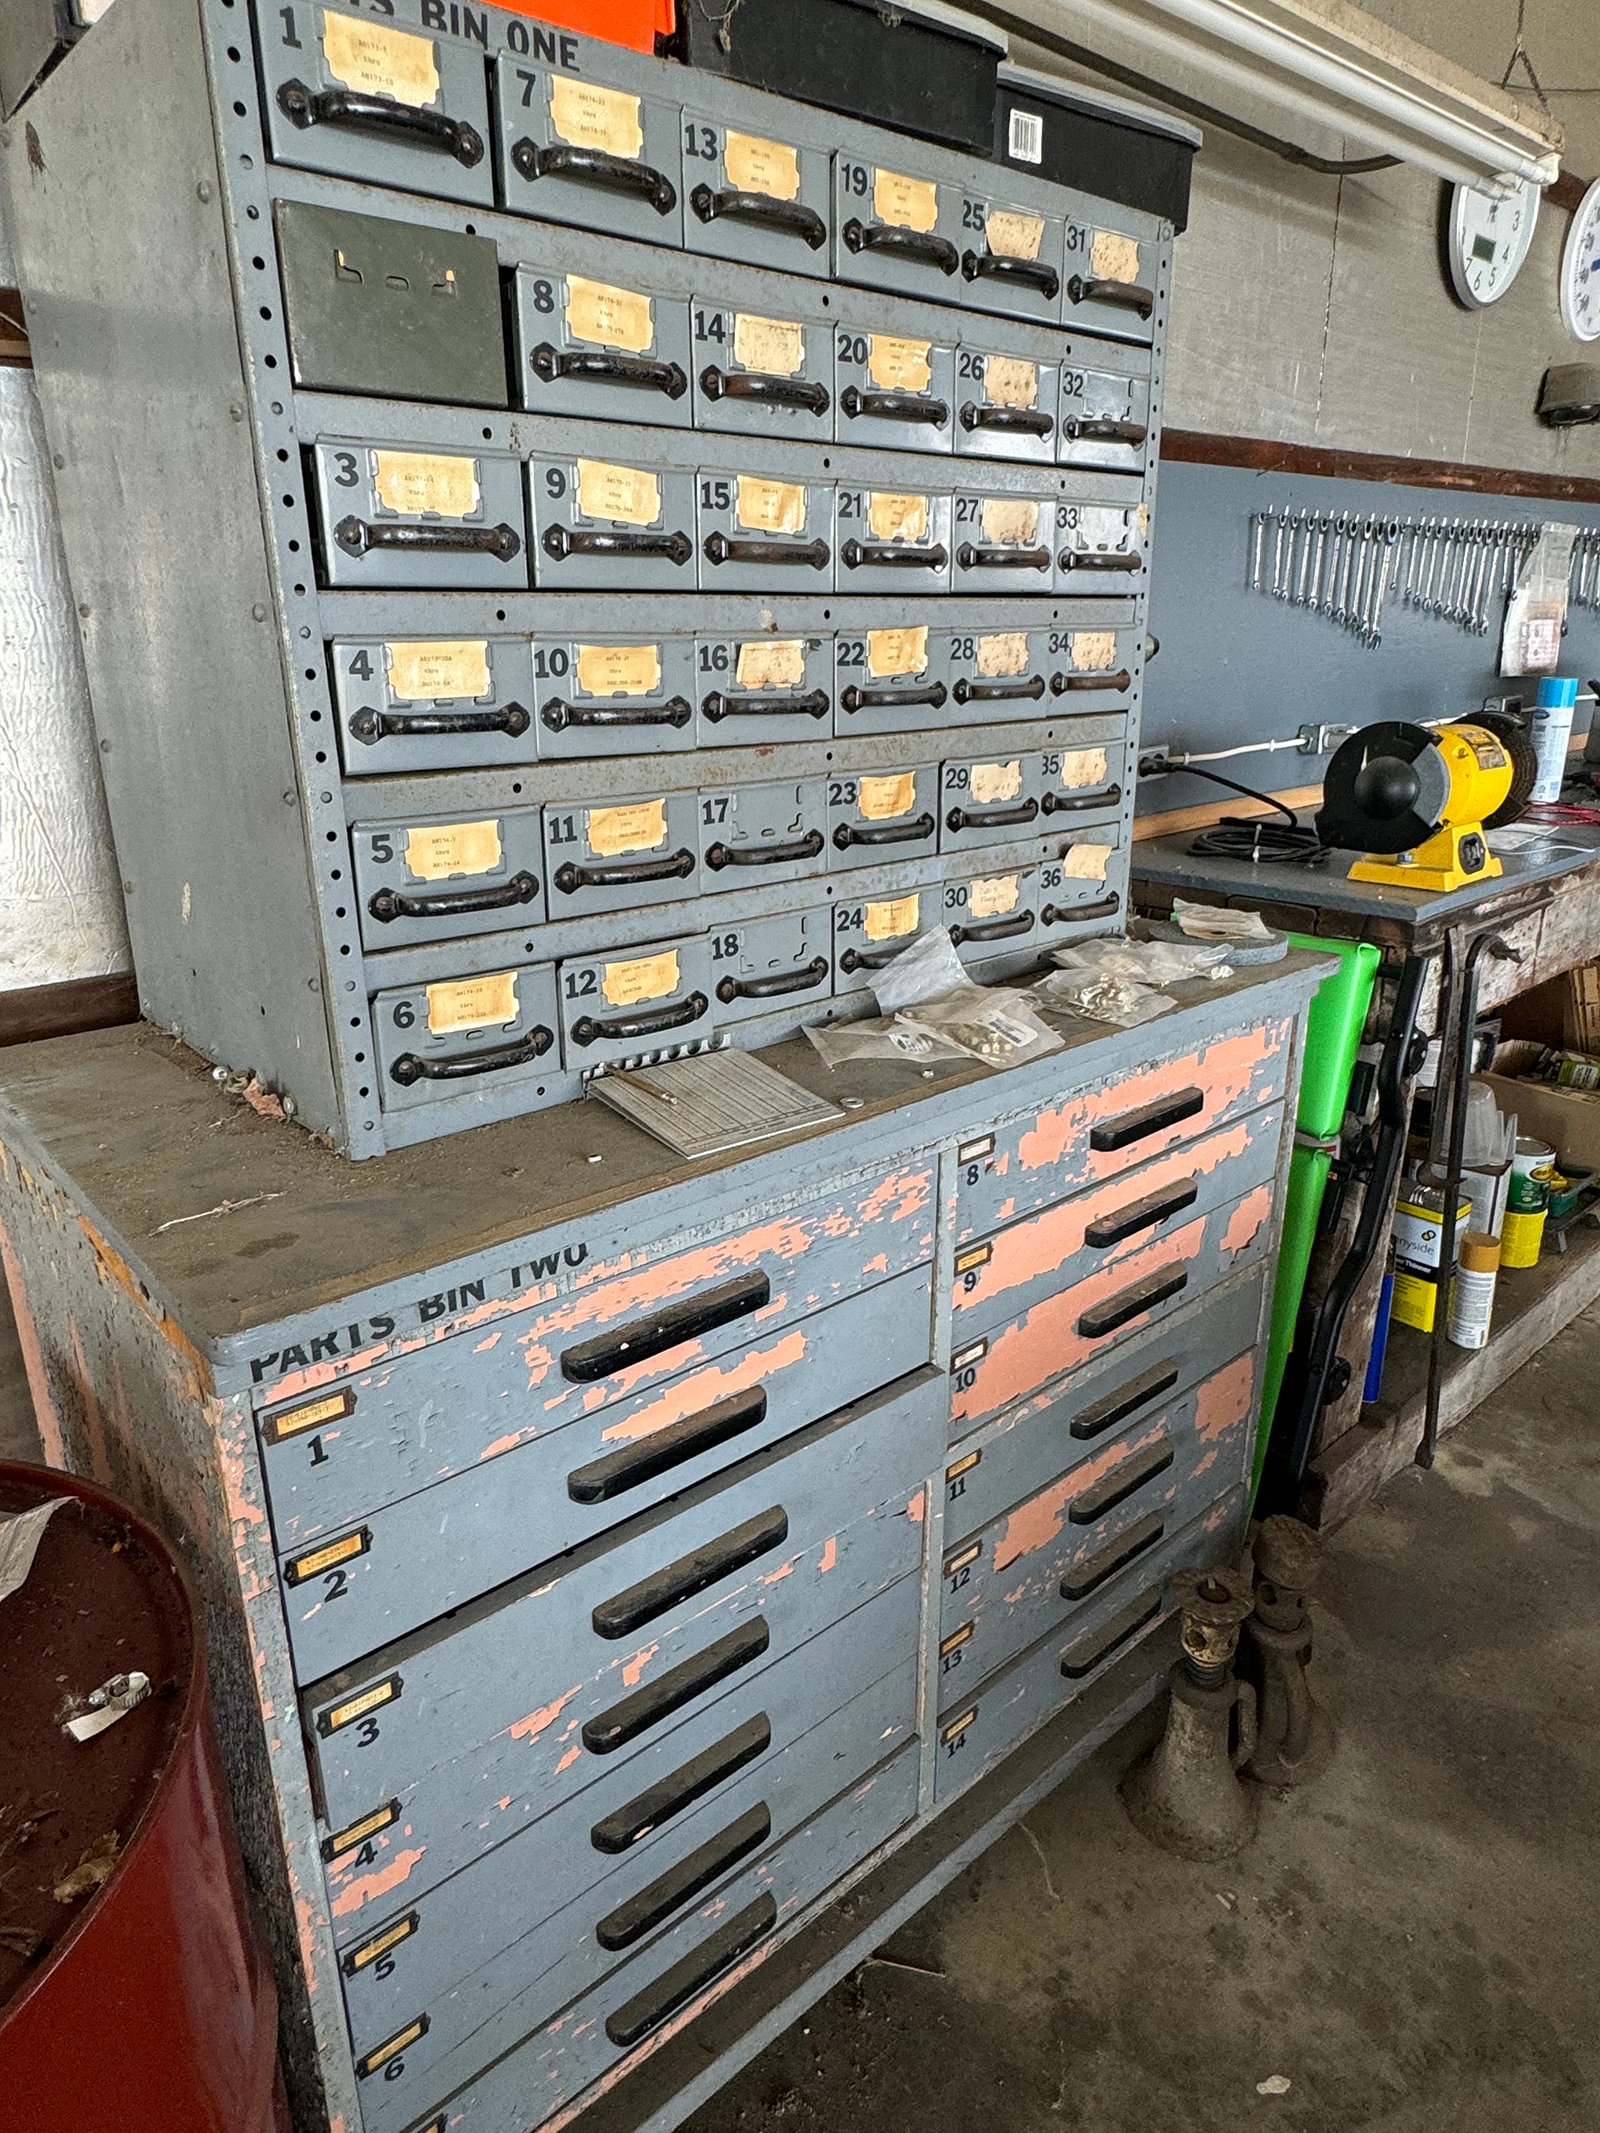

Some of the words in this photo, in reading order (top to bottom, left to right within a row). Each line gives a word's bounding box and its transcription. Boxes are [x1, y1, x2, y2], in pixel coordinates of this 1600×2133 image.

[280, 6, 302, 49] 1
[421, 0, 488, 51] BIN
[507, 20, 580, 72] ONE
[517, 69, 535, 107] 7
[685, 124, 717, 161] 13
[842, 164, 867, 196] 19
[963, 200, 986, 233] 25
[1512, 210, 1520, 231] 3
[1067, 226, 1085, 252] 31
[1466, 257, 1473, 272] 7
[1502, 244, 1510, 263] 4
[1474, 271, 1482, 291] 6
[1489, 266, 1497, 287] 5
[534, 280, 554, 313] 8
[695, 311, 725, 343] 14
[838, 335, 868, 364] 20
[960, 353, 984, 380] 26
[1063, 372, 1083, 397] 32
[335, 453, 359, 487] 3
[546, 468, 565, 498] 9
[702, 482, 730, 510] 15
[839, 492, 860, 518] 21
[956, 498, 978, 522] 27
[1057, 507, 1077, 529] 33
[837, 642, 864, 666] 22
[951, 638, 973, 660] 28
[1049, 633, 1069, 654] 34
[349, 650, 374, 681] 4
[535, 649, 568, 678] 10
[700, 645, 728, 671] 16
[1042, 755, 1058, 775] 35
[946, 768, 968, 789] 29
[829, 782, 856, 806] 23
[703, 798, 728, 825] 17
[549, 816, 577, 844] 11
[372, 834, 393, 863] 5
[1041, 868, 1061, 889] 36
[945, 887, 967, 908] 30
[837, 908, 864, 931] 24
[712, 934, 738, 960] 18
[566, 970, 597, 999] 12
[393, 1002, 414, 1028] 6
[967, 1165, 978, 1186] 8
[964, 1271, 976, 1292] 9
[419, 1279, 486, 1323] BIN
[956, 1368, 975, 1393] 10
[307, 1435, 329, 1466] 1
[949, 1478, 966, 1500] 11
[322, 1570, 348, 1603] 2
[950, 1568, 970, 1594] 12
[942, 1648, 963, 1673] 13
[356, 1717, 380, 1748] 3
[947, 1732, 966, 1758] 14
[354, 1841, 378, 1868] 4
[374, 1954, 395, 1981] 5
[384, 2056, 405, 2081] 6
